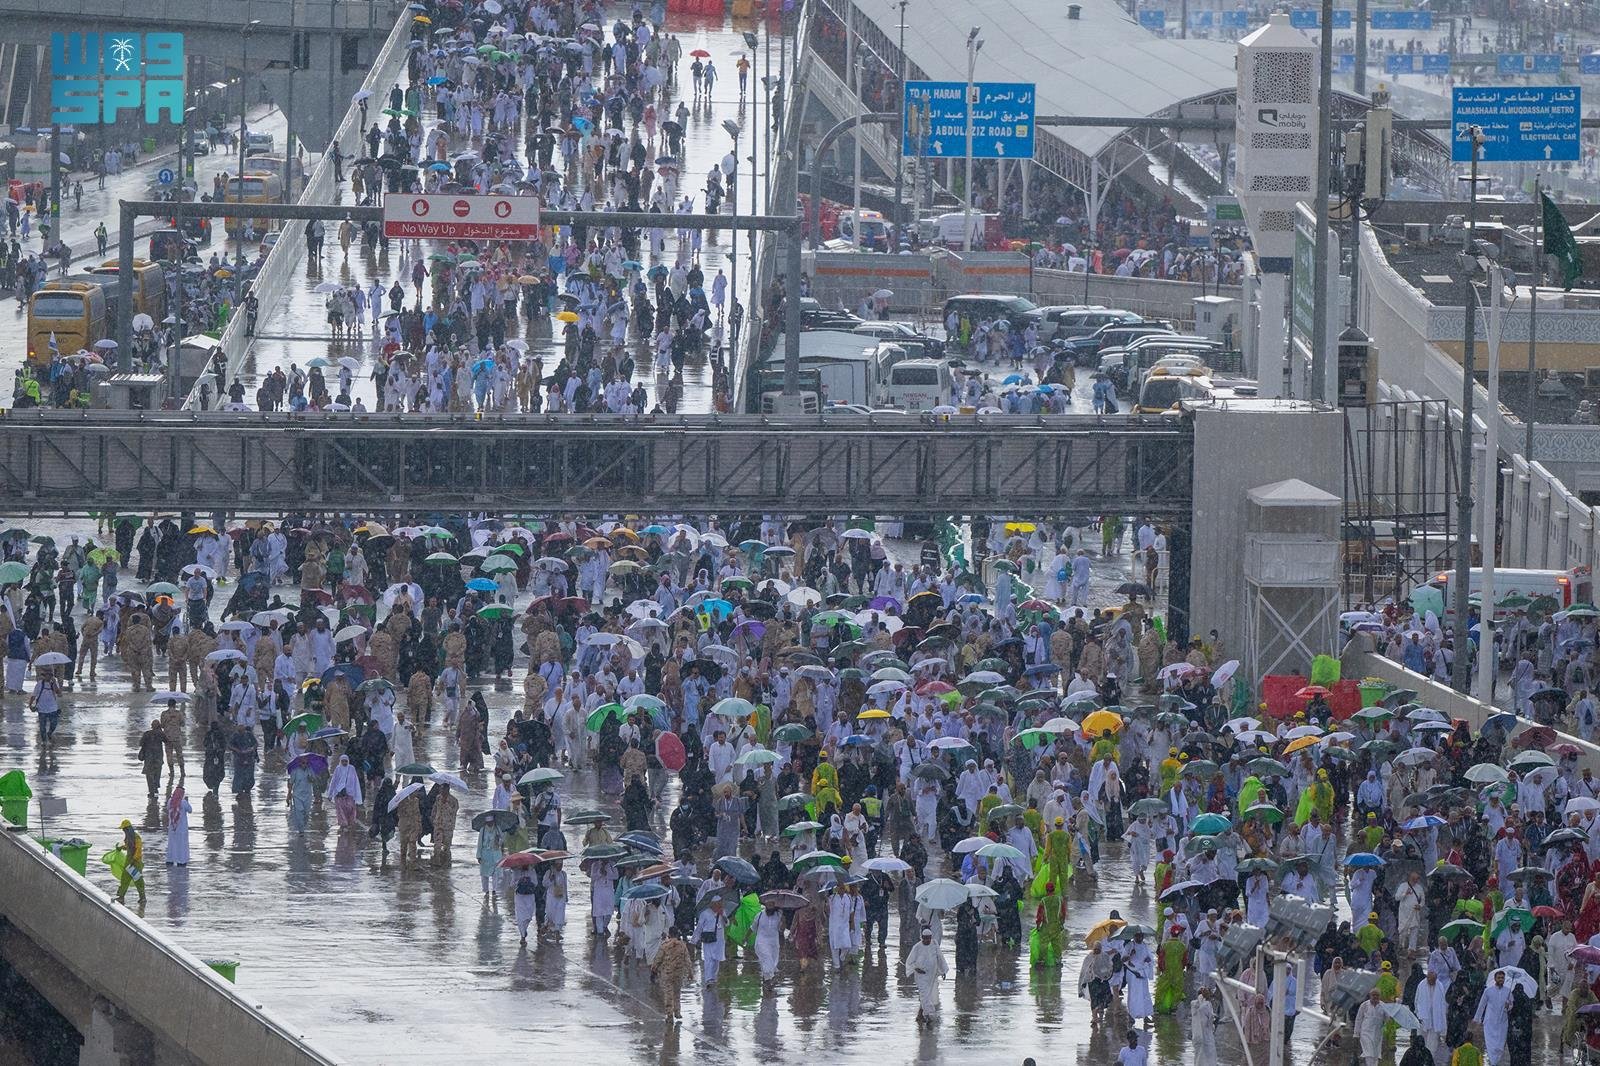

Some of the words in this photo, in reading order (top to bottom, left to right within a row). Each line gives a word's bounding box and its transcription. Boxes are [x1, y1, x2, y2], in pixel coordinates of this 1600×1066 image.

[910, 88, 920, 98] TO
[934, 89, 961, 99] HARAM
[985, 91, 1014, 104] الحرم
[1458, 92, 1500, 102] المقدسة
[1504, 90, 1544, 104] المشاعر
[1548, 89, 1576, 103] قطار
[1456, 106, 1498, 114] ALMASHAAR
[1551, 106, 1574, 114] METRO
[944, 111, 964, 121] عبد
[1000, 110, 1029, 122] طريق
[936, 126, 985, 136] ABDULZIZ
[988, 127, 1012, 137] ROAD
[402, 224, 416, 233] No
[418, 224, 439, 236] Way
[442, 225, 456, 236] Up
[463, 226, 492, 237] الدخول
